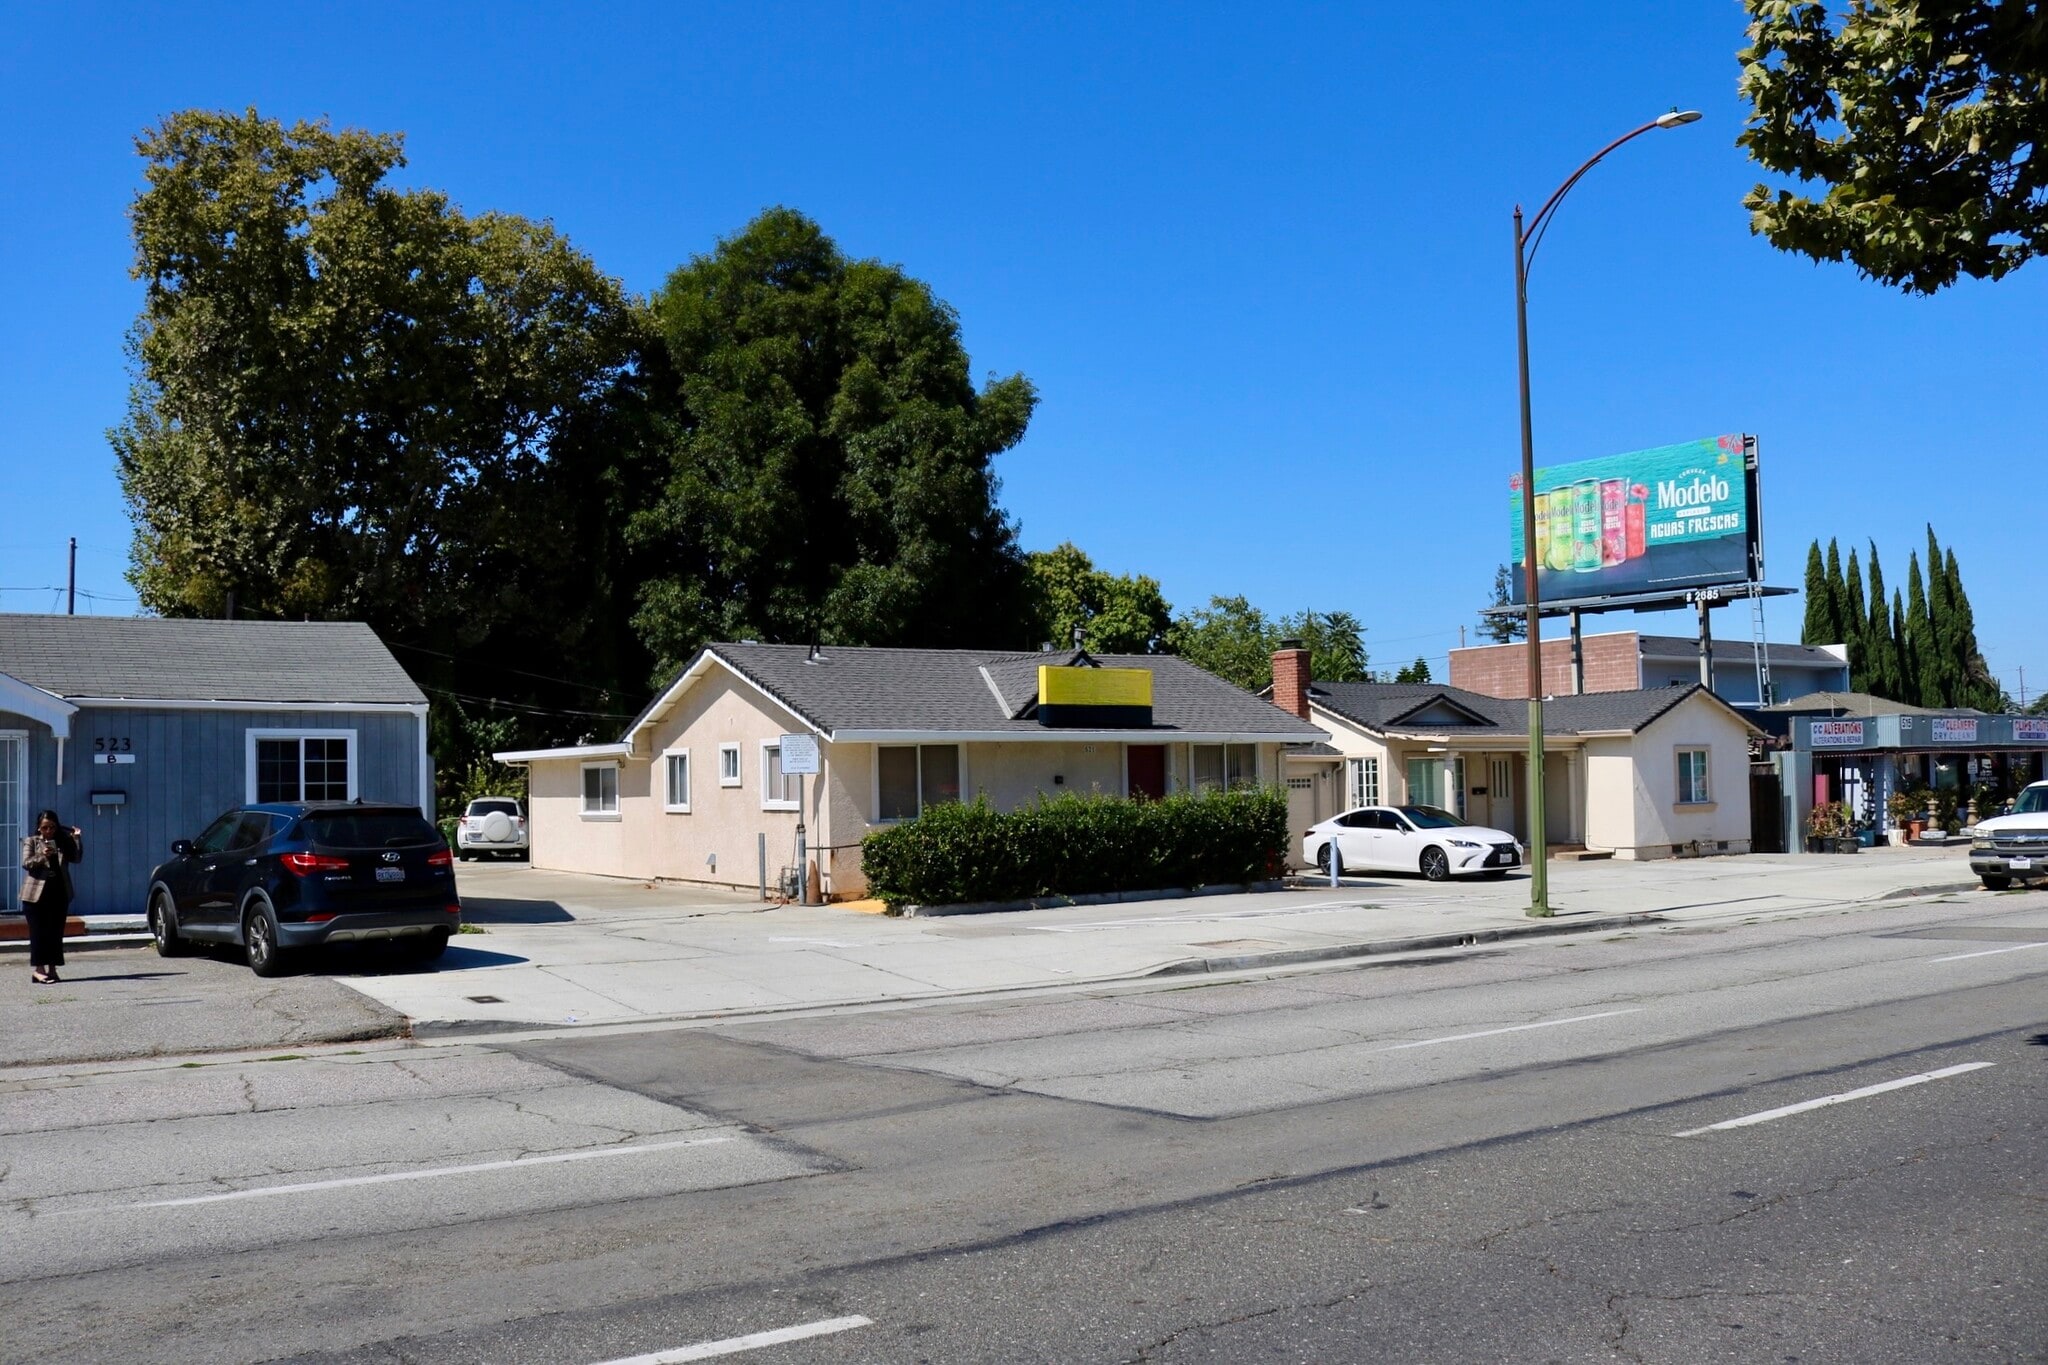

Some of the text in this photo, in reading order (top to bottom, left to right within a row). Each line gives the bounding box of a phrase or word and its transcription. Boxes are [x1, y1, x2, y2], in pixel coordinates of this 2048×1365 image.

[1678, 467, 1706, 479] CERVEZA
[1658, 475, 1729, 509] Modelo
[1651, 513, 1739, 539] AGUAS FRESCAS
[1694, 589, 1719, 601] 2685
[1824, 723, 1861, 735] ALTERATIONS
[1945, 720, 1975, 731] CLEANERS
[1934, 732, 1948, 740] DRY
[95, 737, 131, 751] 523
[107, 755, 117, 764] B
